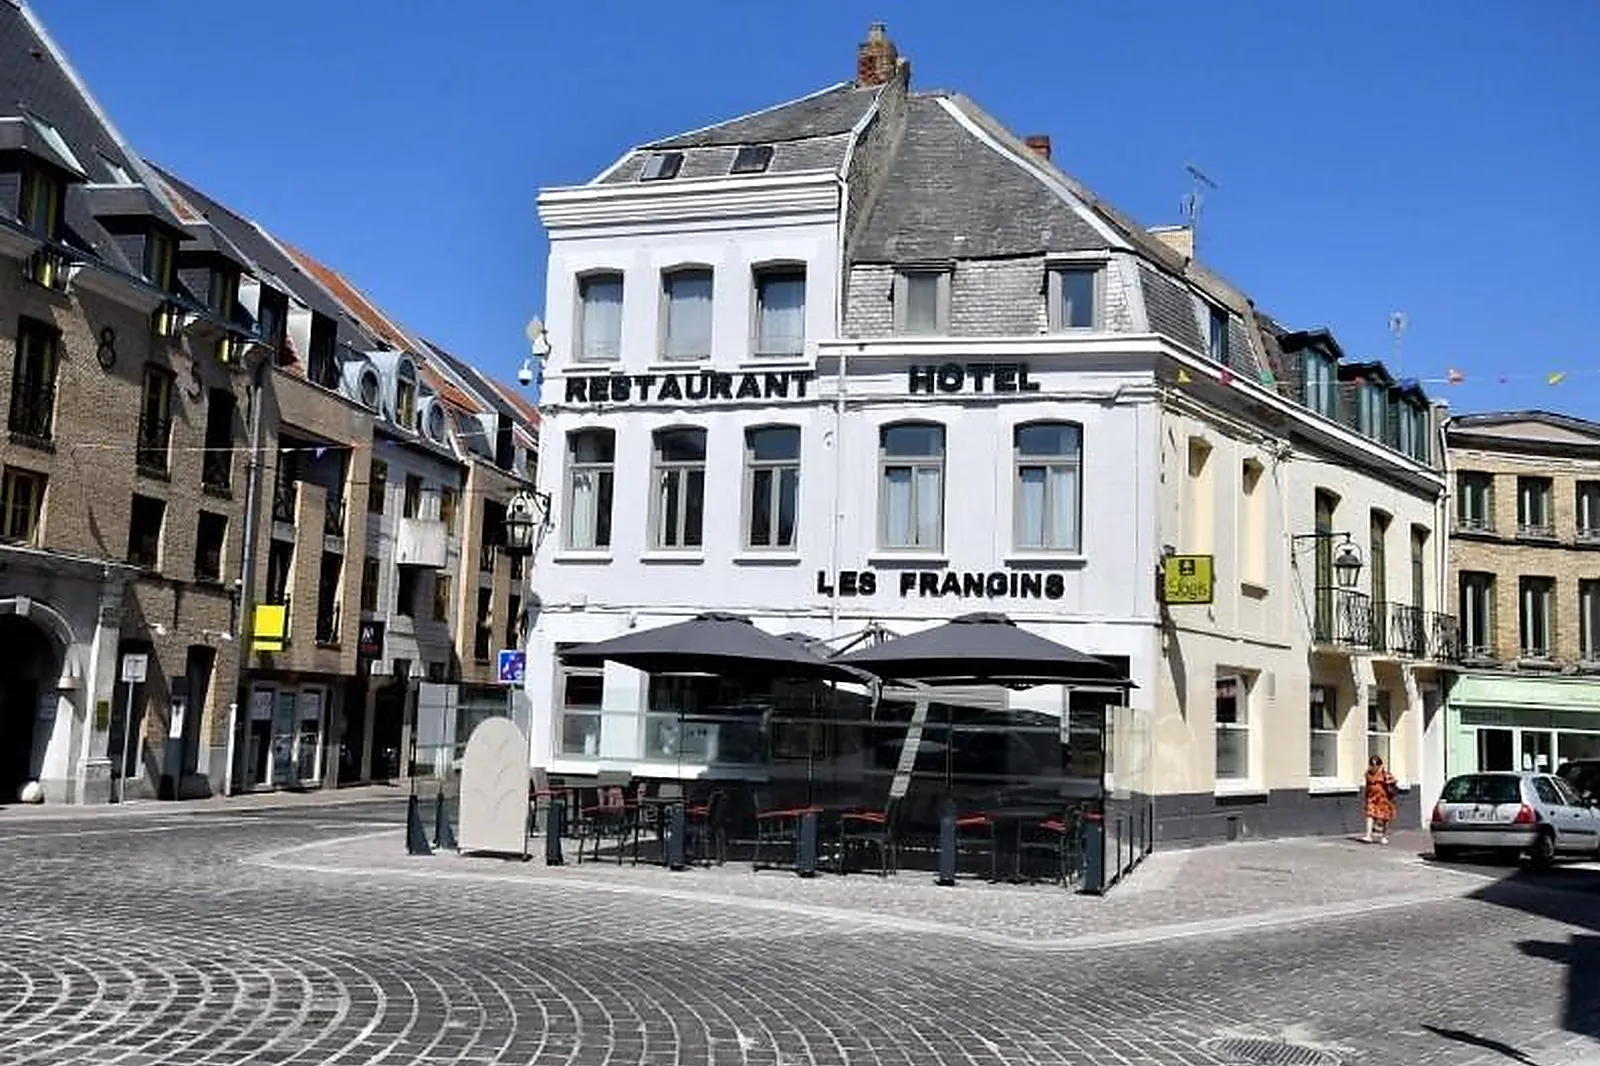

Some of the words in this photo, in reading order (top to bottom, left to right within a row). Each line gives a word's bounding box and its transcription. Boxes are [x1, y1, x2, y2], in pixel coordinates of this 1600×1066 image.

[565, 370, 815, 403] RESTAURANT
[909, 362, 1040, 394] HOTEL
[817, 571, 877, 597] LES
[900, 571, 1065, 600] FRANGINS
